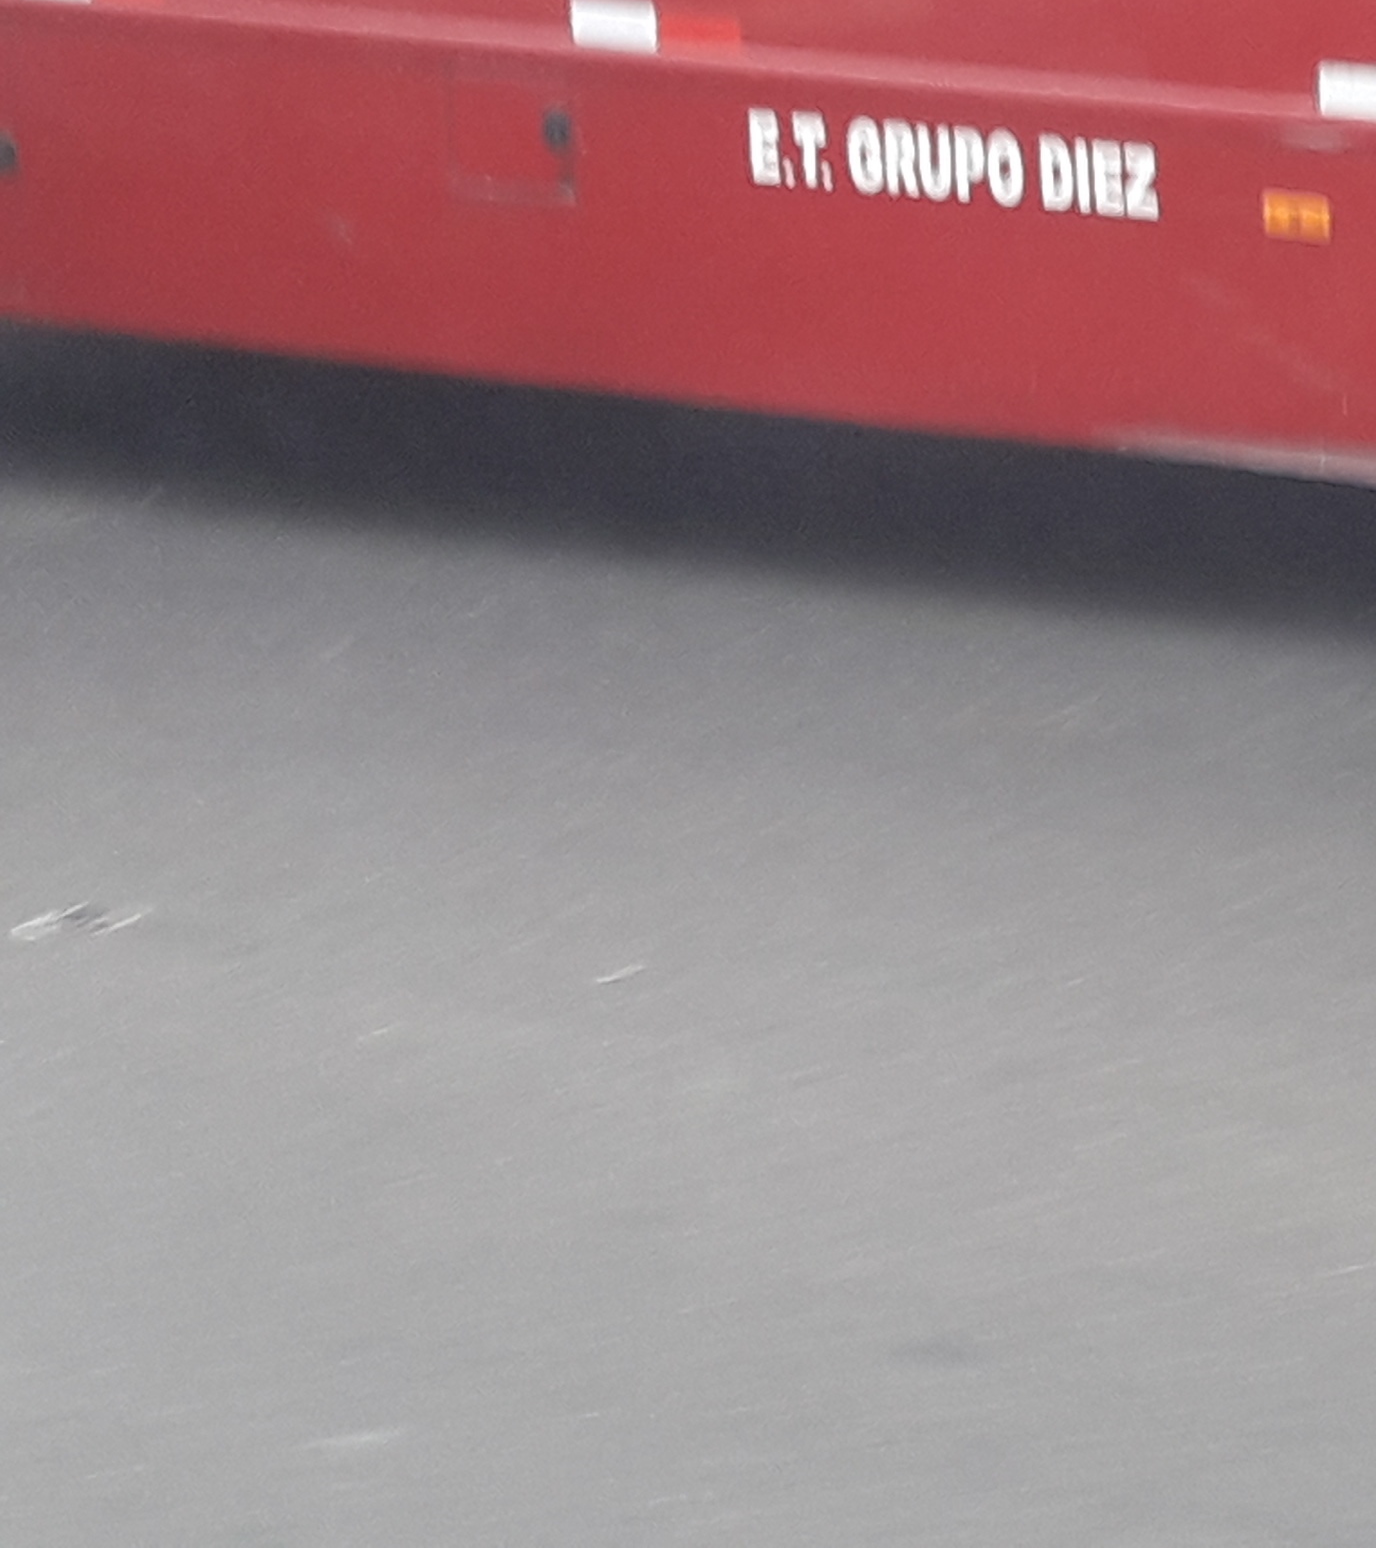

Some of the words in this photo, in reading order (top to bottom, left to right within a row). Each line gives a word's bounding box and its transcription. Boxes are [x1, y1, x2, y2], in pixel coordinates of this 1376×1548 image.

[747, 106, 834, 193] E.T.
[845, 114, 1026, 209] GRUPO
[1037, 132, 1161, 223] DIEZ
